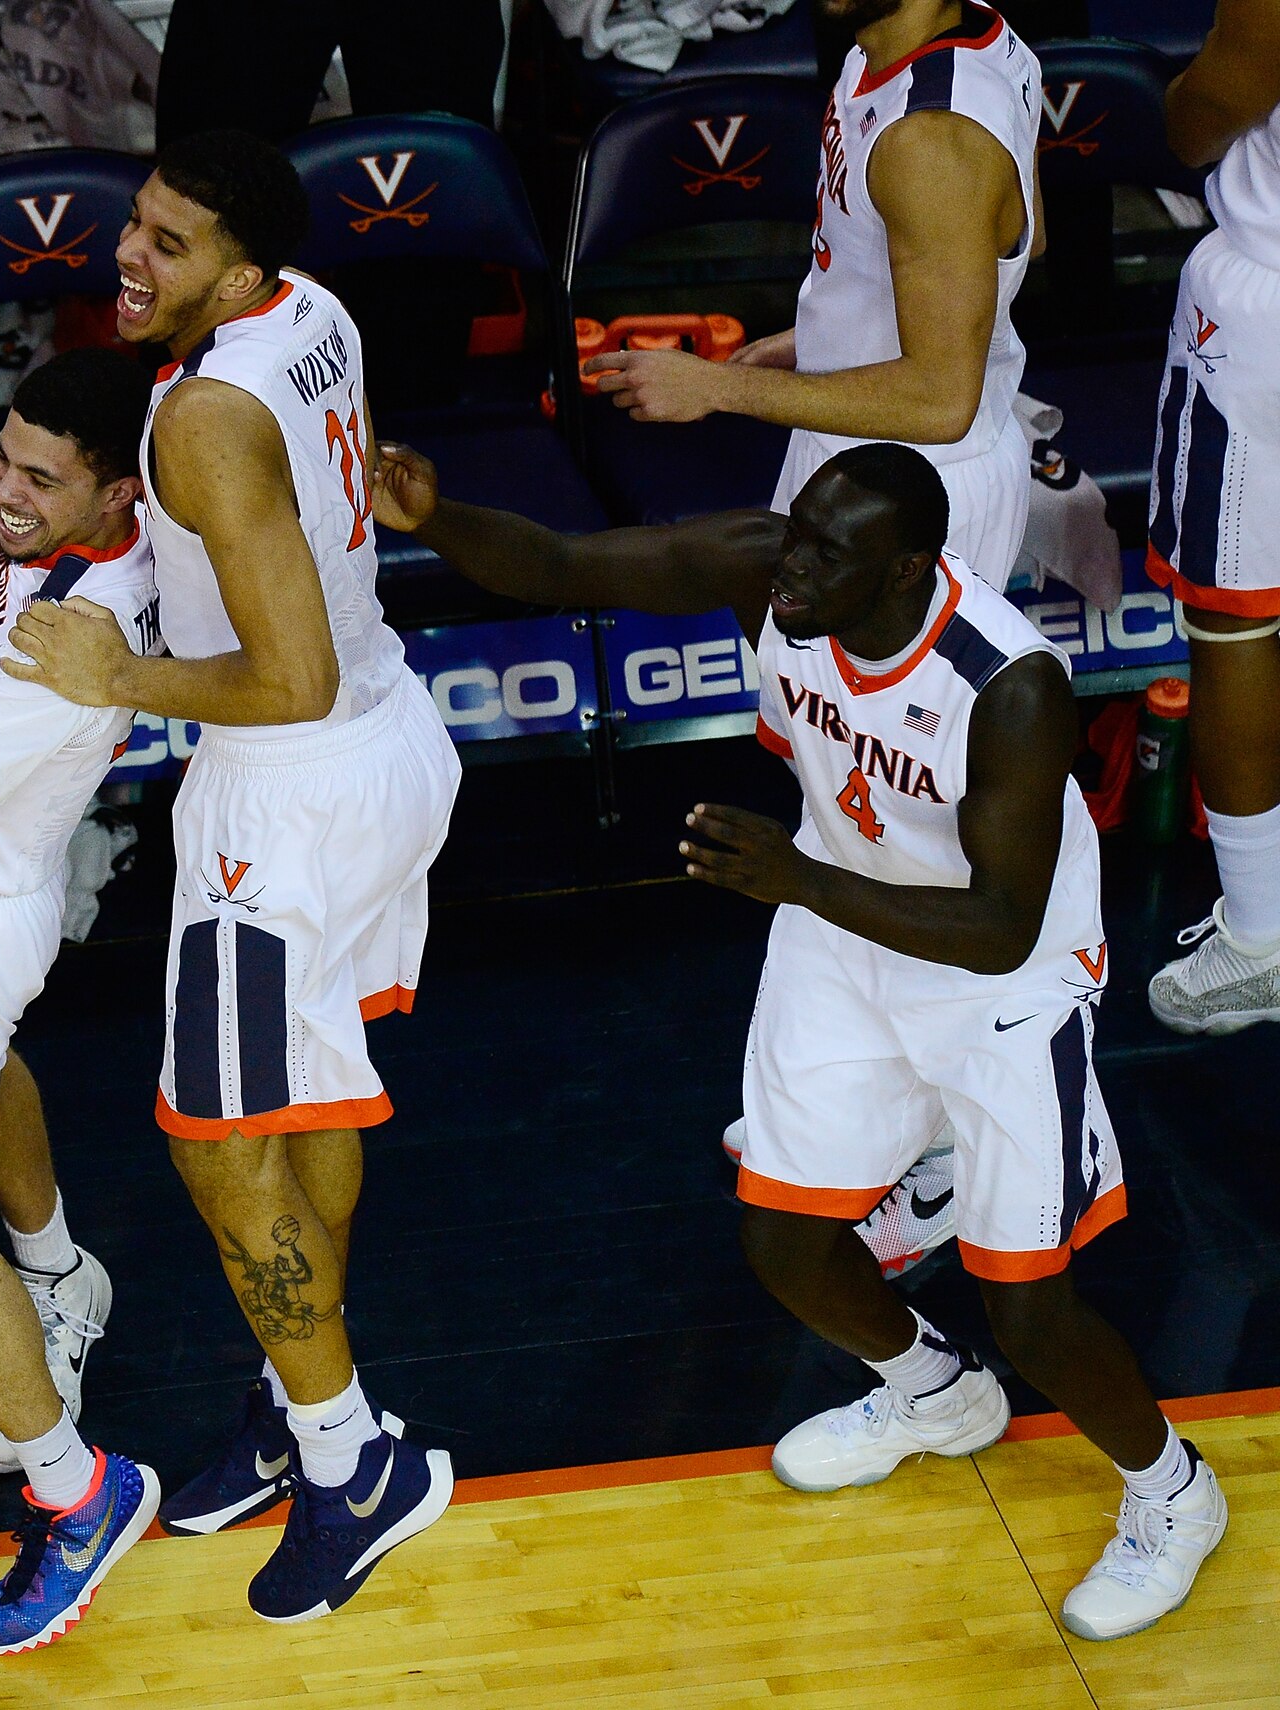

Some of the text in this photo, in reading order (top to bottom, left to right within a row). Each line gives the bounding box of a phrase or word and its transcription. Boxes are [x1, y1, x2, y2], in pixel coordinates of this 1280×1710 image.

[691, 114, 749, 168] V
[356, 150, 417, 206] V
[16, 193, 74, 247] V
[293, 294, 314, 325] ACC
[1023, 591, 1189, 656] EIC
[419, 660, 577, 727] CO
[624, 636, 760, 706] GEI
[836, 765, 886, 848] 4
[216, 850, 253, 897] V
[1072, 941, 1107, 985] V
